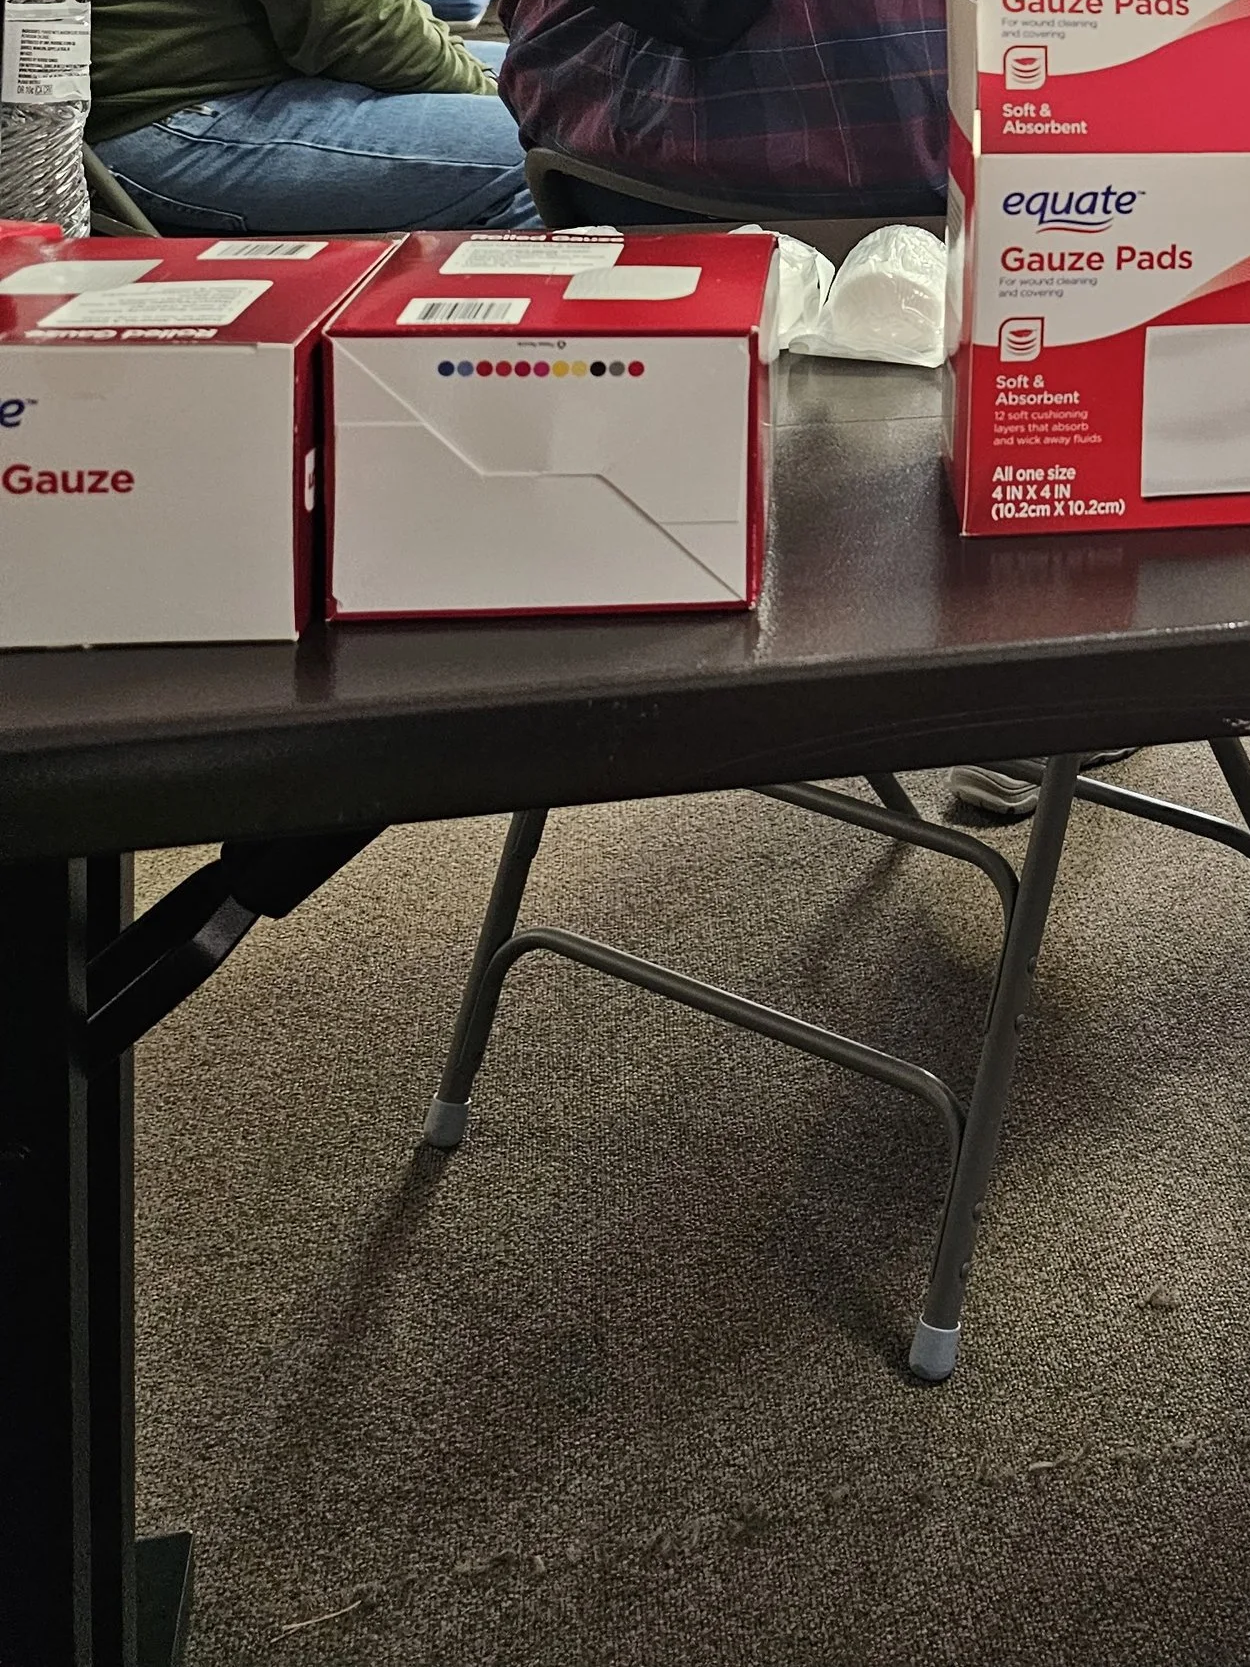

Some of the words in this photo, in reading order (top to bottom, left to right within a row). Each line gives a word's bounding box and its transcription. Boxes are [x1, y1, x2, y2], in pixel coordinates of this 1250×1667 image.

[1001, 18, 1018, 27] For
[1021, 18, 1055, 28] wound
[1057, 18, 1098, 30] cleaning
[1001, 30, 1020, 39] and
[1023, 31, 1066, 40] covering
[1002, 102, 1036, 117] Soft
[1039, 102, 1051, 117] &
[1002, 119, 1088, 134] Absorbent
[1000, 246, 1105, 272] Gauze
[1116, 243, 1193, 271] Pads
[999, 276, 1016, 286] For
[1019, 277, 1054, 286] wound
[1056, 276, 1098, 287] cleaning
[999, 288, 1018, 298] and
[1020, 288, 1064, 299] covering
[121, 328, 218, 341] Rolled
[996, 375, 1029, 389] Soft
[1033, 374, 1045, 388] &
[995, 390, 1080, 405] Absorbent
[994, 411, 1005, 421] 12
[1008, 410, 1028, 420] soft
[1031, 409, 1088, 420] cushioning
[993, 424, 1025, 434] layers
[1028, 422, 1049, 432] that
[1052, 422, 1089, 432] absorb
[993, 436, 1013, 446] and
[1017, 435, 1040, 445] wick
[1043, 436, 1071, 446] away
[1074, 433, 1102, 444] fluids
[2, 463, 135, 495] Gauze
[992, 466, 1013, 482] All
[1016, 467, 1045, 481] one
[1047, 464, 1076, 480] size
[991, 486, 1003, 501] 4
[1006, 485, 1023, 500] IN
[1026, 485, 1037, 500] X
[1040, 484, 1051, 500] 4
[1054, 483, 1071, 499] IN
[991, 502, 1050, 521] (10.2cm
[1054, 501, 1065, 516] X
[1068, 499, 1126, 516] 10.2cm)
